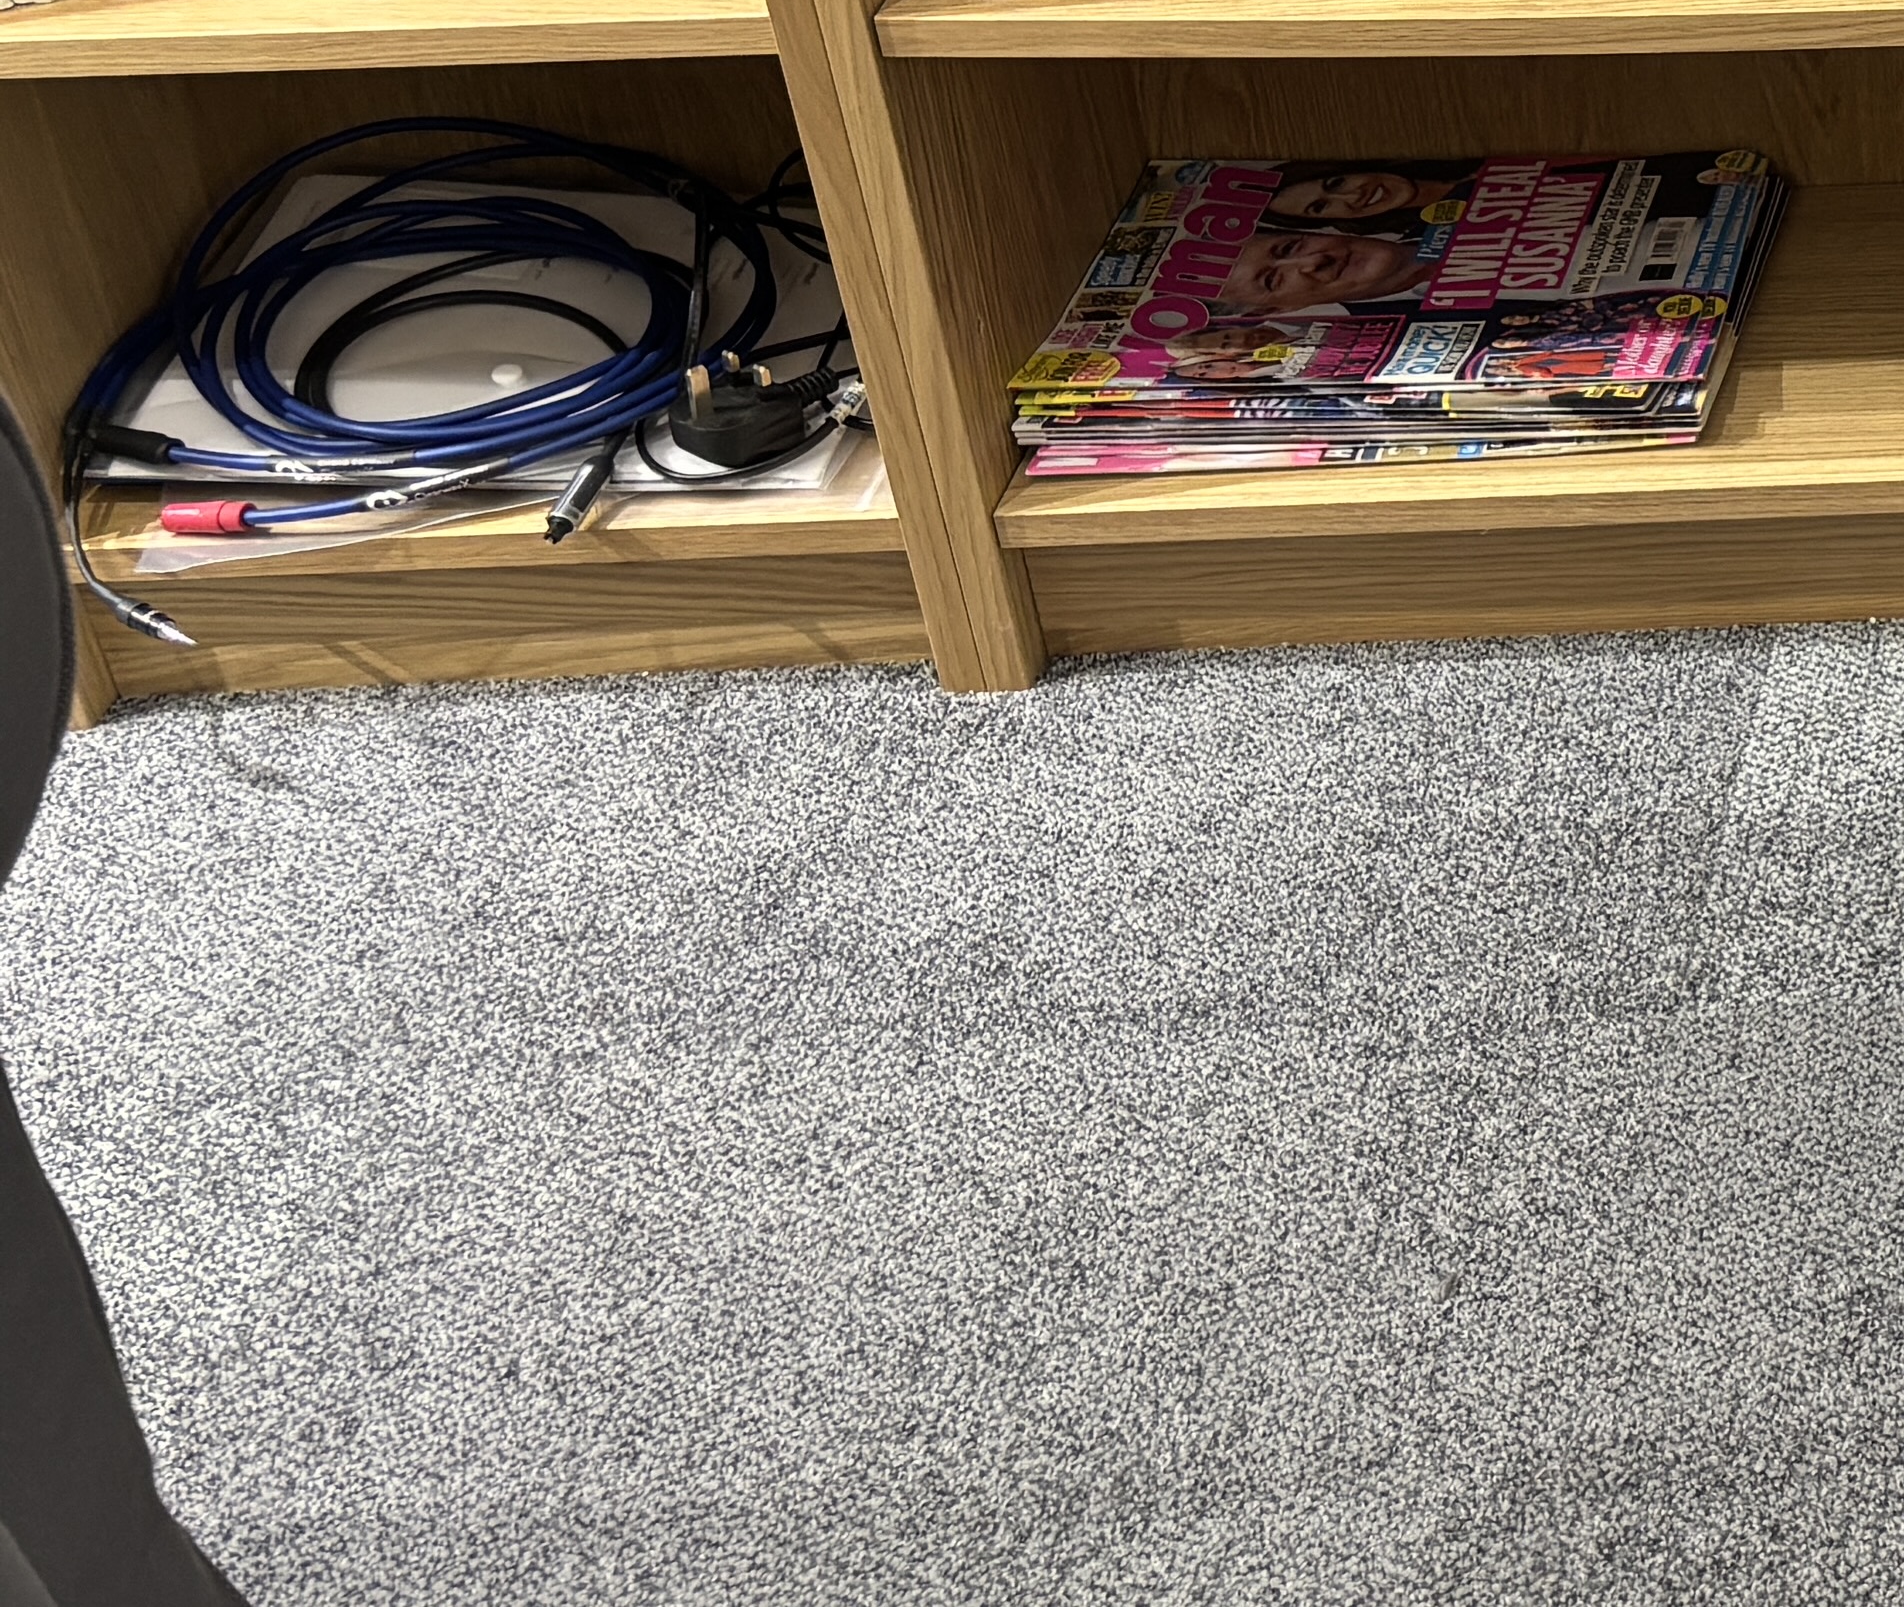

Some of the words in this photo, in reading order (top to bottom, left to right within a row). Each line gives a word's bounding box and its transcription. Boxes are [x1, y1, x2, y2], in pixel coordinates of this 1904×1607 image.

[1465, 160, 1546, 220] STEAL
[1606, 161, 1640, 199] determined
[1598, 206, 1620, 220] star
[1415, 226, 1454, 258] Piers
[1437, 227, 1518, 281] WILL
[1582, 221, 1620, 261] outspoken
[1571, 277, 1599, 293] Why
[1576, 262, 1600, 274] the
[1408, 325, 1460, 374] QUICK!
